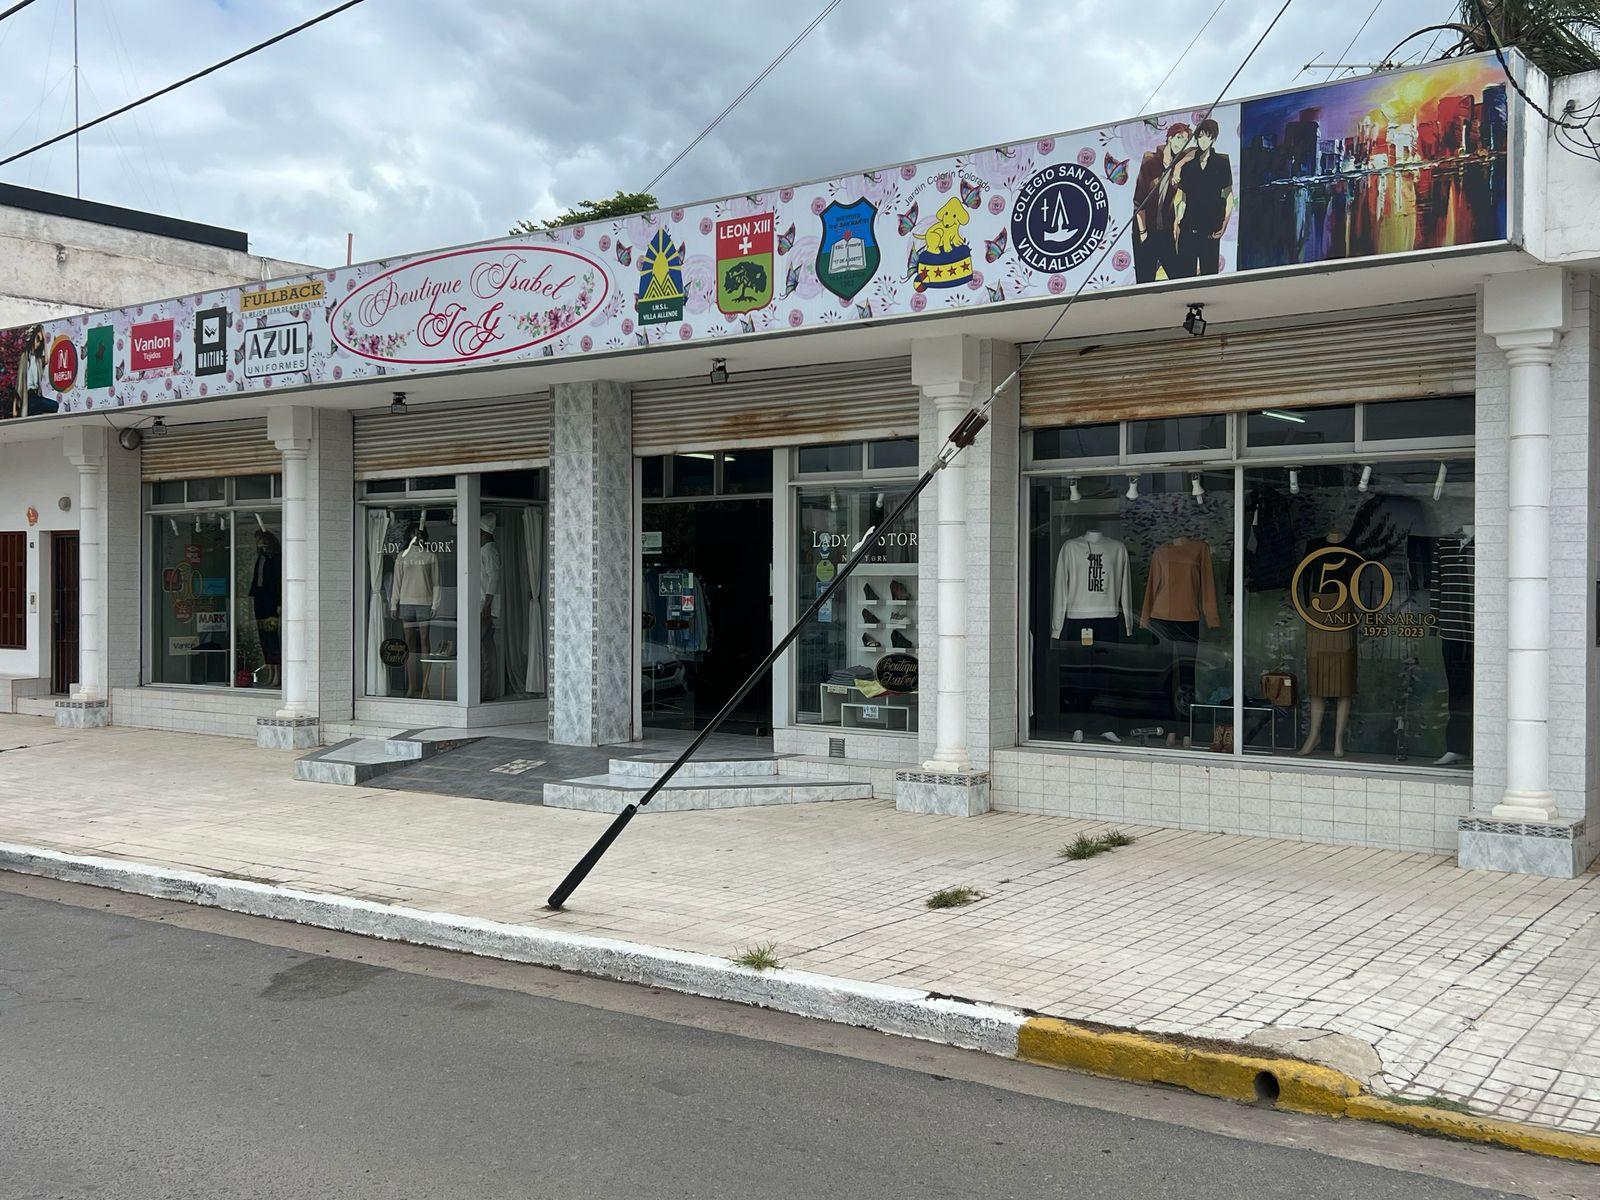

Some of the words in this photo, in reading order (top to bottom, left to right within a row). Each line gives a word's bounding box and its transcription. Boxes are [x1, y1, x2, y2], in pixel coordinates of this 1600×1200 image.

[957, 169, 991, 192] Colorado
[1013, 169, 1054, 222] COLEGIO
[1058, 165, 1086, 180] SAN
[1084, 176, 1106, 210] JOSE
[720, 222, 750, 239] LEON
[753, 219, 770, 234] XIII
[1018, 237, 1047, 270] VILLA
[1048, 228, 1103, 271] ALLENDE
[243, 283, 322, 308] FULLBACK
[358, 275, 462, 327] Boutique
[469, 253, 576, 299] Isabel
[657, 310, 678, 318] ALLENDE
[134, 335, 171, 352] Vanlon
[248, 328, 304, 360] AZUL
[143, 351, 161, 361] Tejidos
[247, 359, 305, 374] UNIFORMES
[376, 539, 401, 554] LADY
[812, 530, 850, 548] LADY
[1088, 579, 1104, 592] URE
[1311, 557, 1394, 613] 50
[198, 614, 225, 624] MARK
[1323, 612, 1436, 626] ANIVERSARIO
[1363, 627, 1388, 637] 1973
[1399, 627, 1424, 637] 2023
